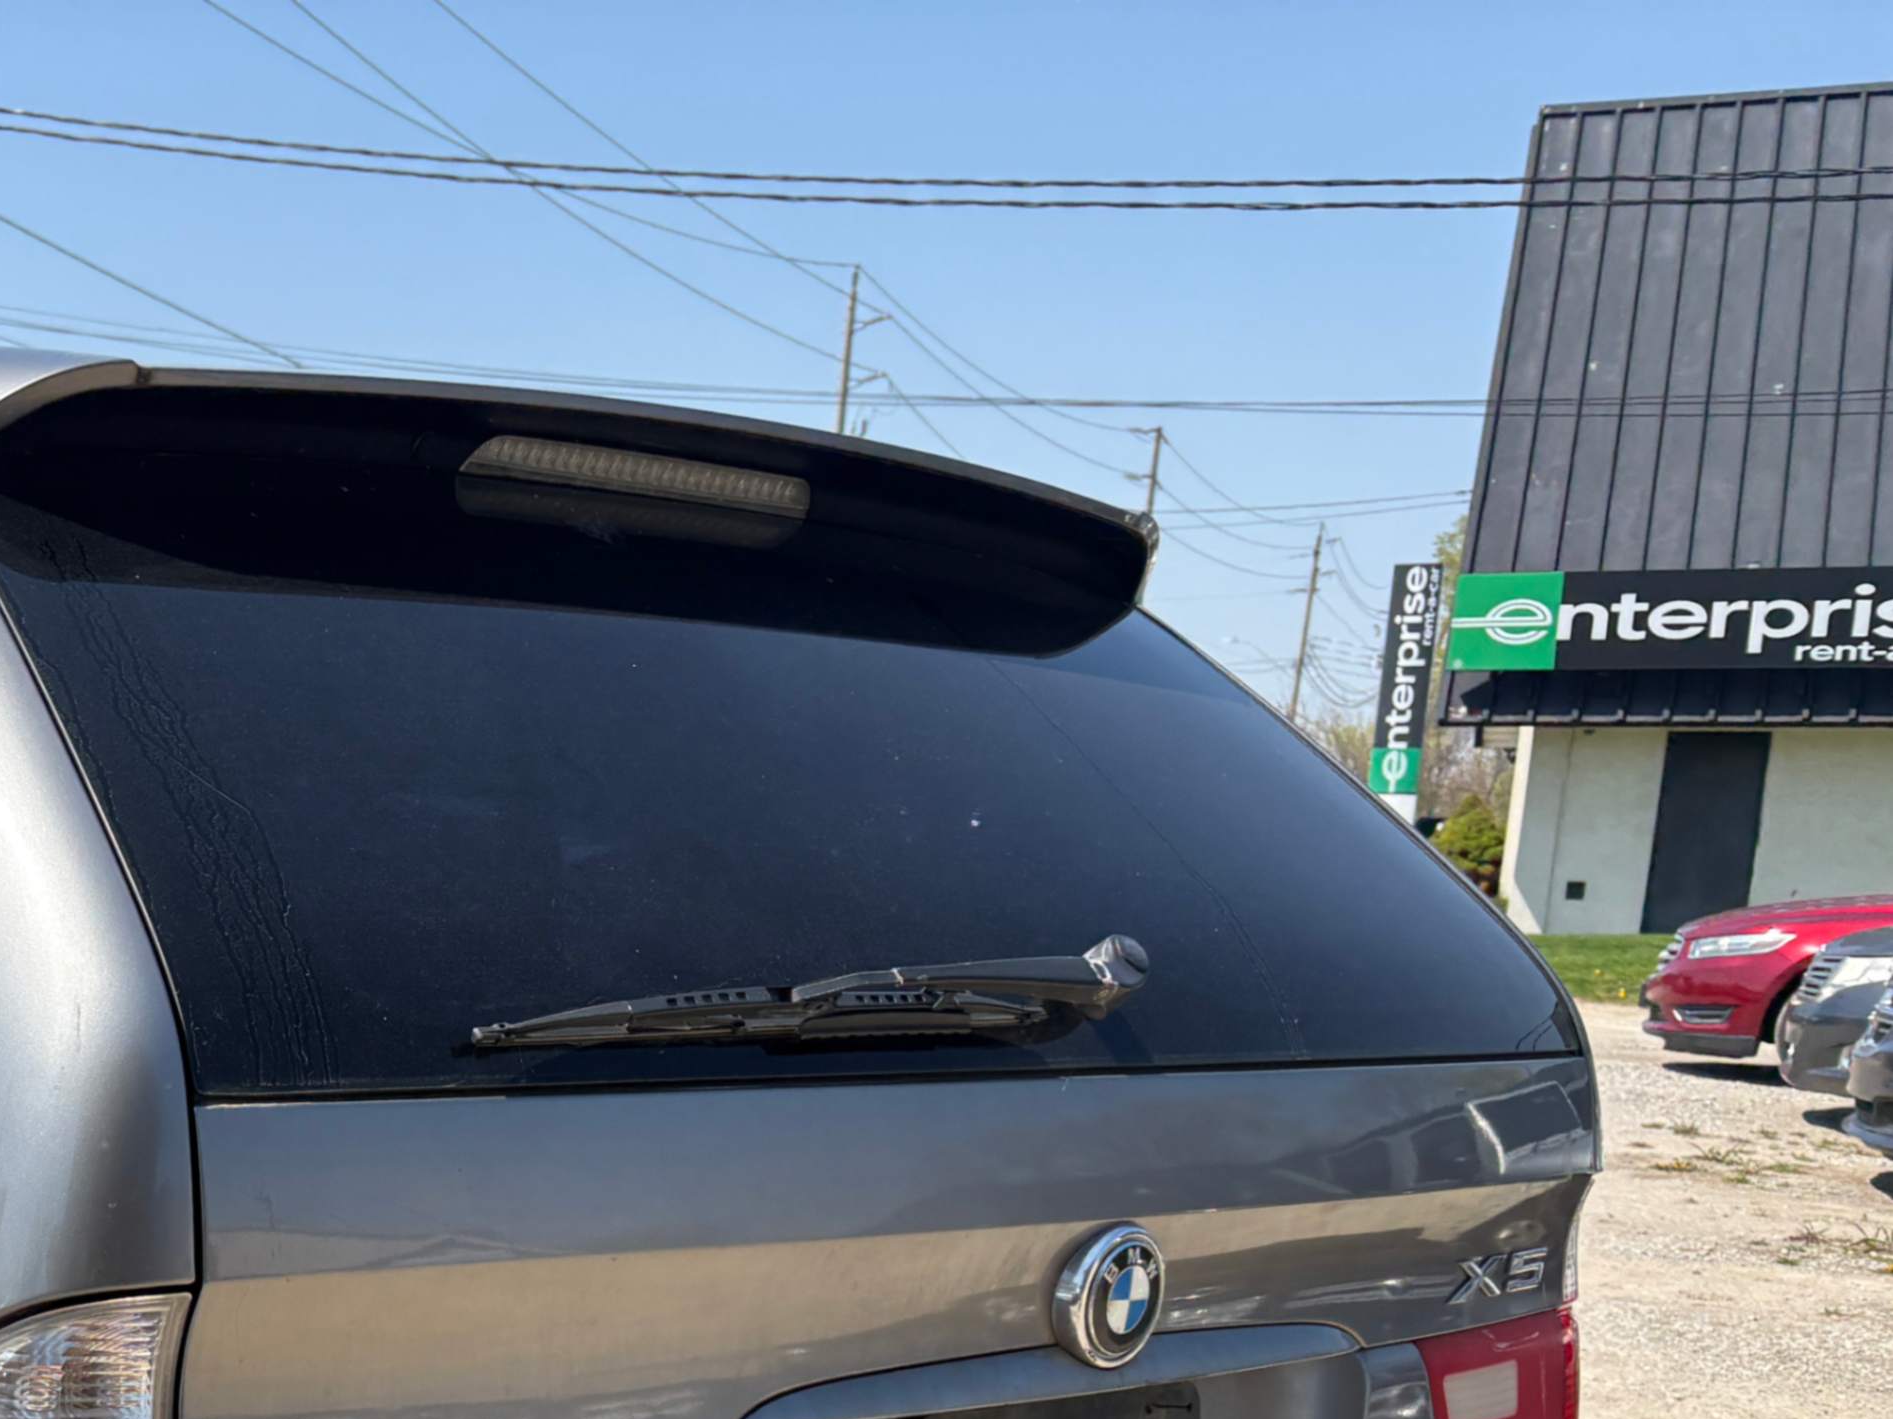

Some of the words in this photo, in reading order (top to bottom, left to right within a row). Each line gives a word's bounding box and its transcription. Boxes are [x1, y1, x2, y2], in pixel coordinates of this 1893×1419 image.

[1422, 567, 1441, 646] rent-a-car
[1381, 565, 1429, 793] enterprise
[1104, 1247, 1159, 1284] BMW
[1445, 1247, 1548, 1305] X5
